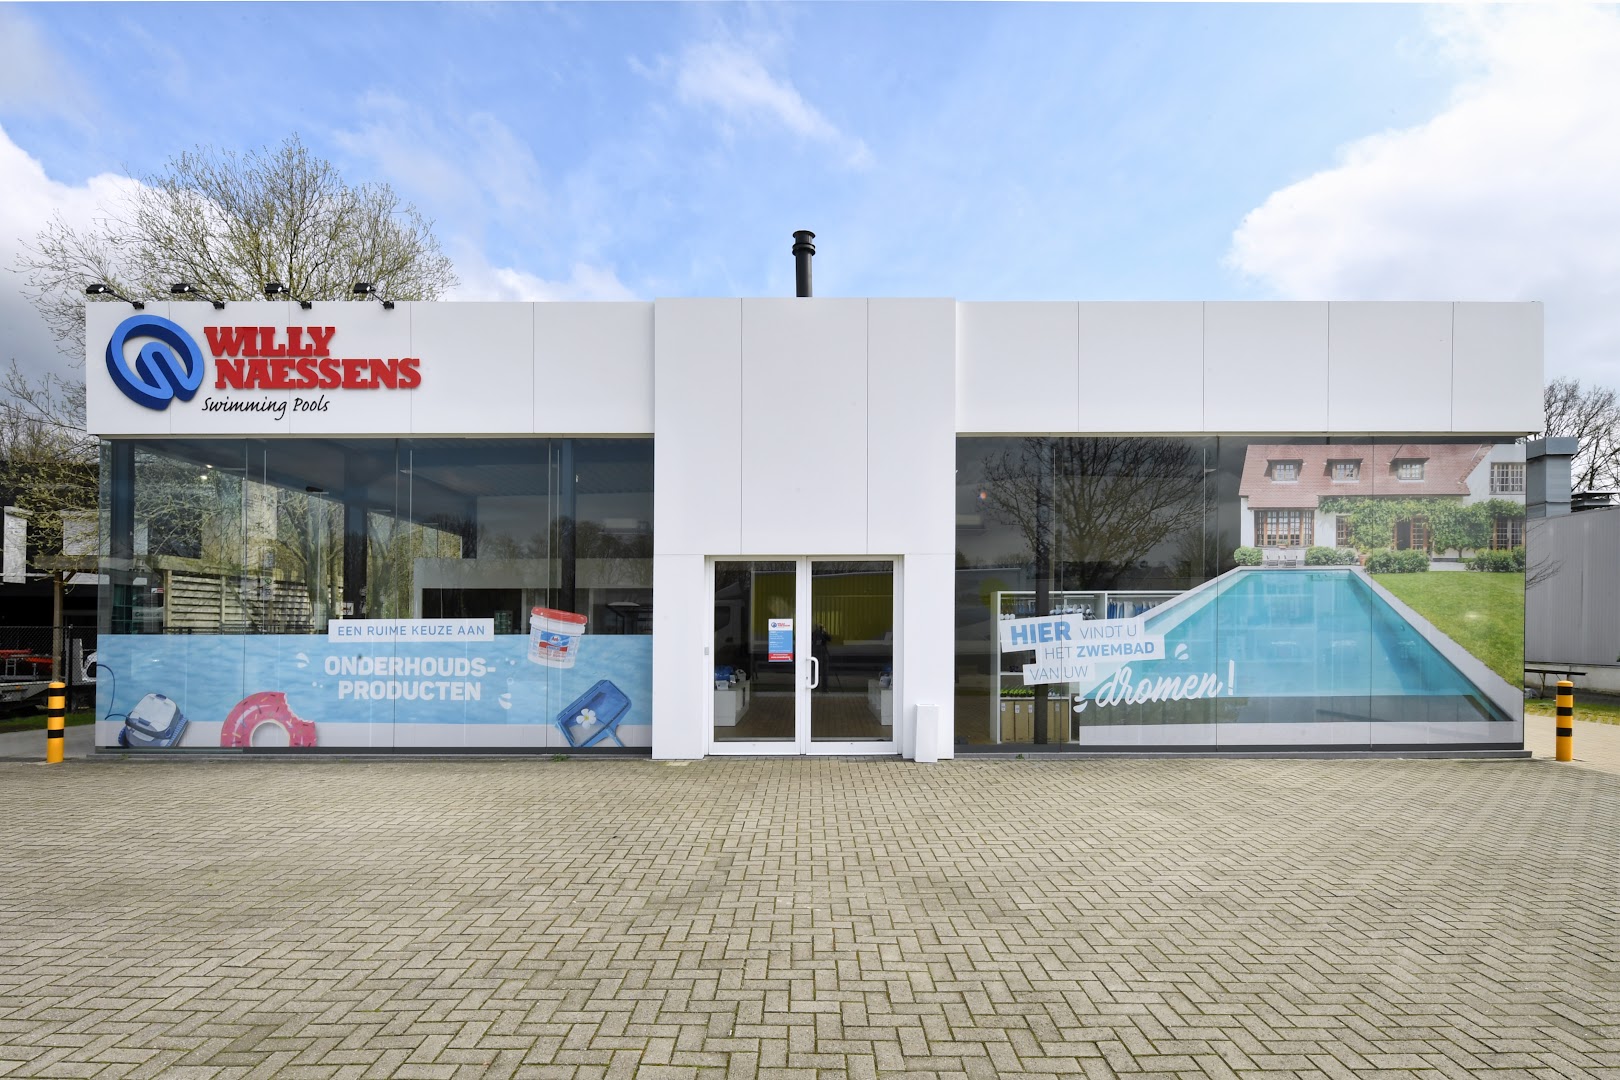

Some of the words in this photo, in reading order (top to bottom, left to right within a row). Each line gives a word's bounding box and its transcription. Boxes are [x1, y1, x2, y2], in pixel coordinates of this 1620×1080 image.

[203, 326, 336, 357] WILLY
[214, 357, 422, 390] NAESSENS
[201, 396, 287, 420] Swimming
[292, 394, 330, 413] Pools
[337, 626, 362, 636] EEN
[366, 625, 407, 636] RUIME
[411, 625, 453, 636] KEUZE
[457, 625, 485, 635] AAN
[1010, 620, 1072, 646] HIER
[1079, 625, 1122, 640] VINDT
[1127, 624, 1137, 637] U
[1044, 646, 1072, 660] HET
[1076, 641, 1155, 658] ZWEMBAD
[324, 655, 497, 677] ONDERHOUDS-
[1029, 667, 1060, 681] VAN
[1063, 665, 1089, 679] UW
[338, 680, 481, 701] PRODUCTEN
[1094, 659, 1235, 707] dromen!
